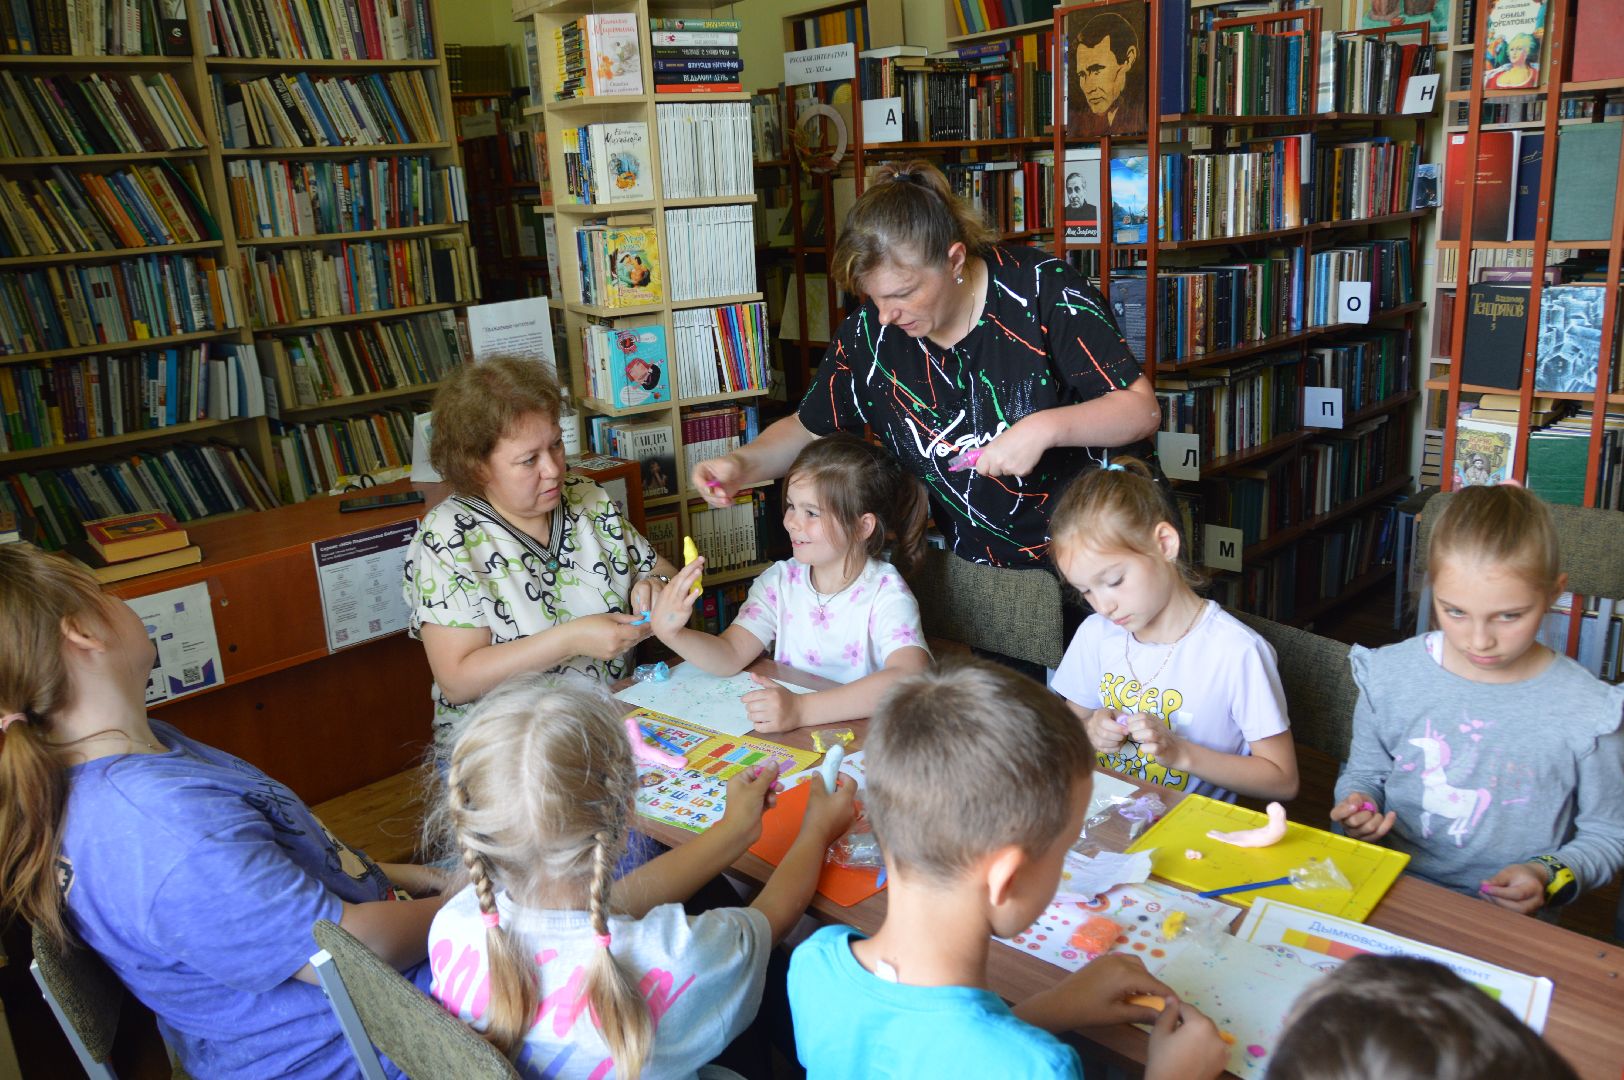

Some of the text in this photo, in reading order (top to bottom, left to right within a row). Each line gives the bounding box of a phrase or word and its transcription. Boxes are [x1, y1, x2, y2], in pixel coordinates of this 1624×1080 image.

[1421, 85, 1435, 102] Н
[885, 108, 897, 125] А
[1346, 296, 1362, 312] О
[1471, 293, 1525, 321] Тендряков
[1322, 401, 1334, 417] П
[633, 432, 667, 448] САНДРА
[1181, 448, 1198, 468] Л
[1219, 540, 1235, 558] М
[1307, 920, 1404, 956] Дымковский
